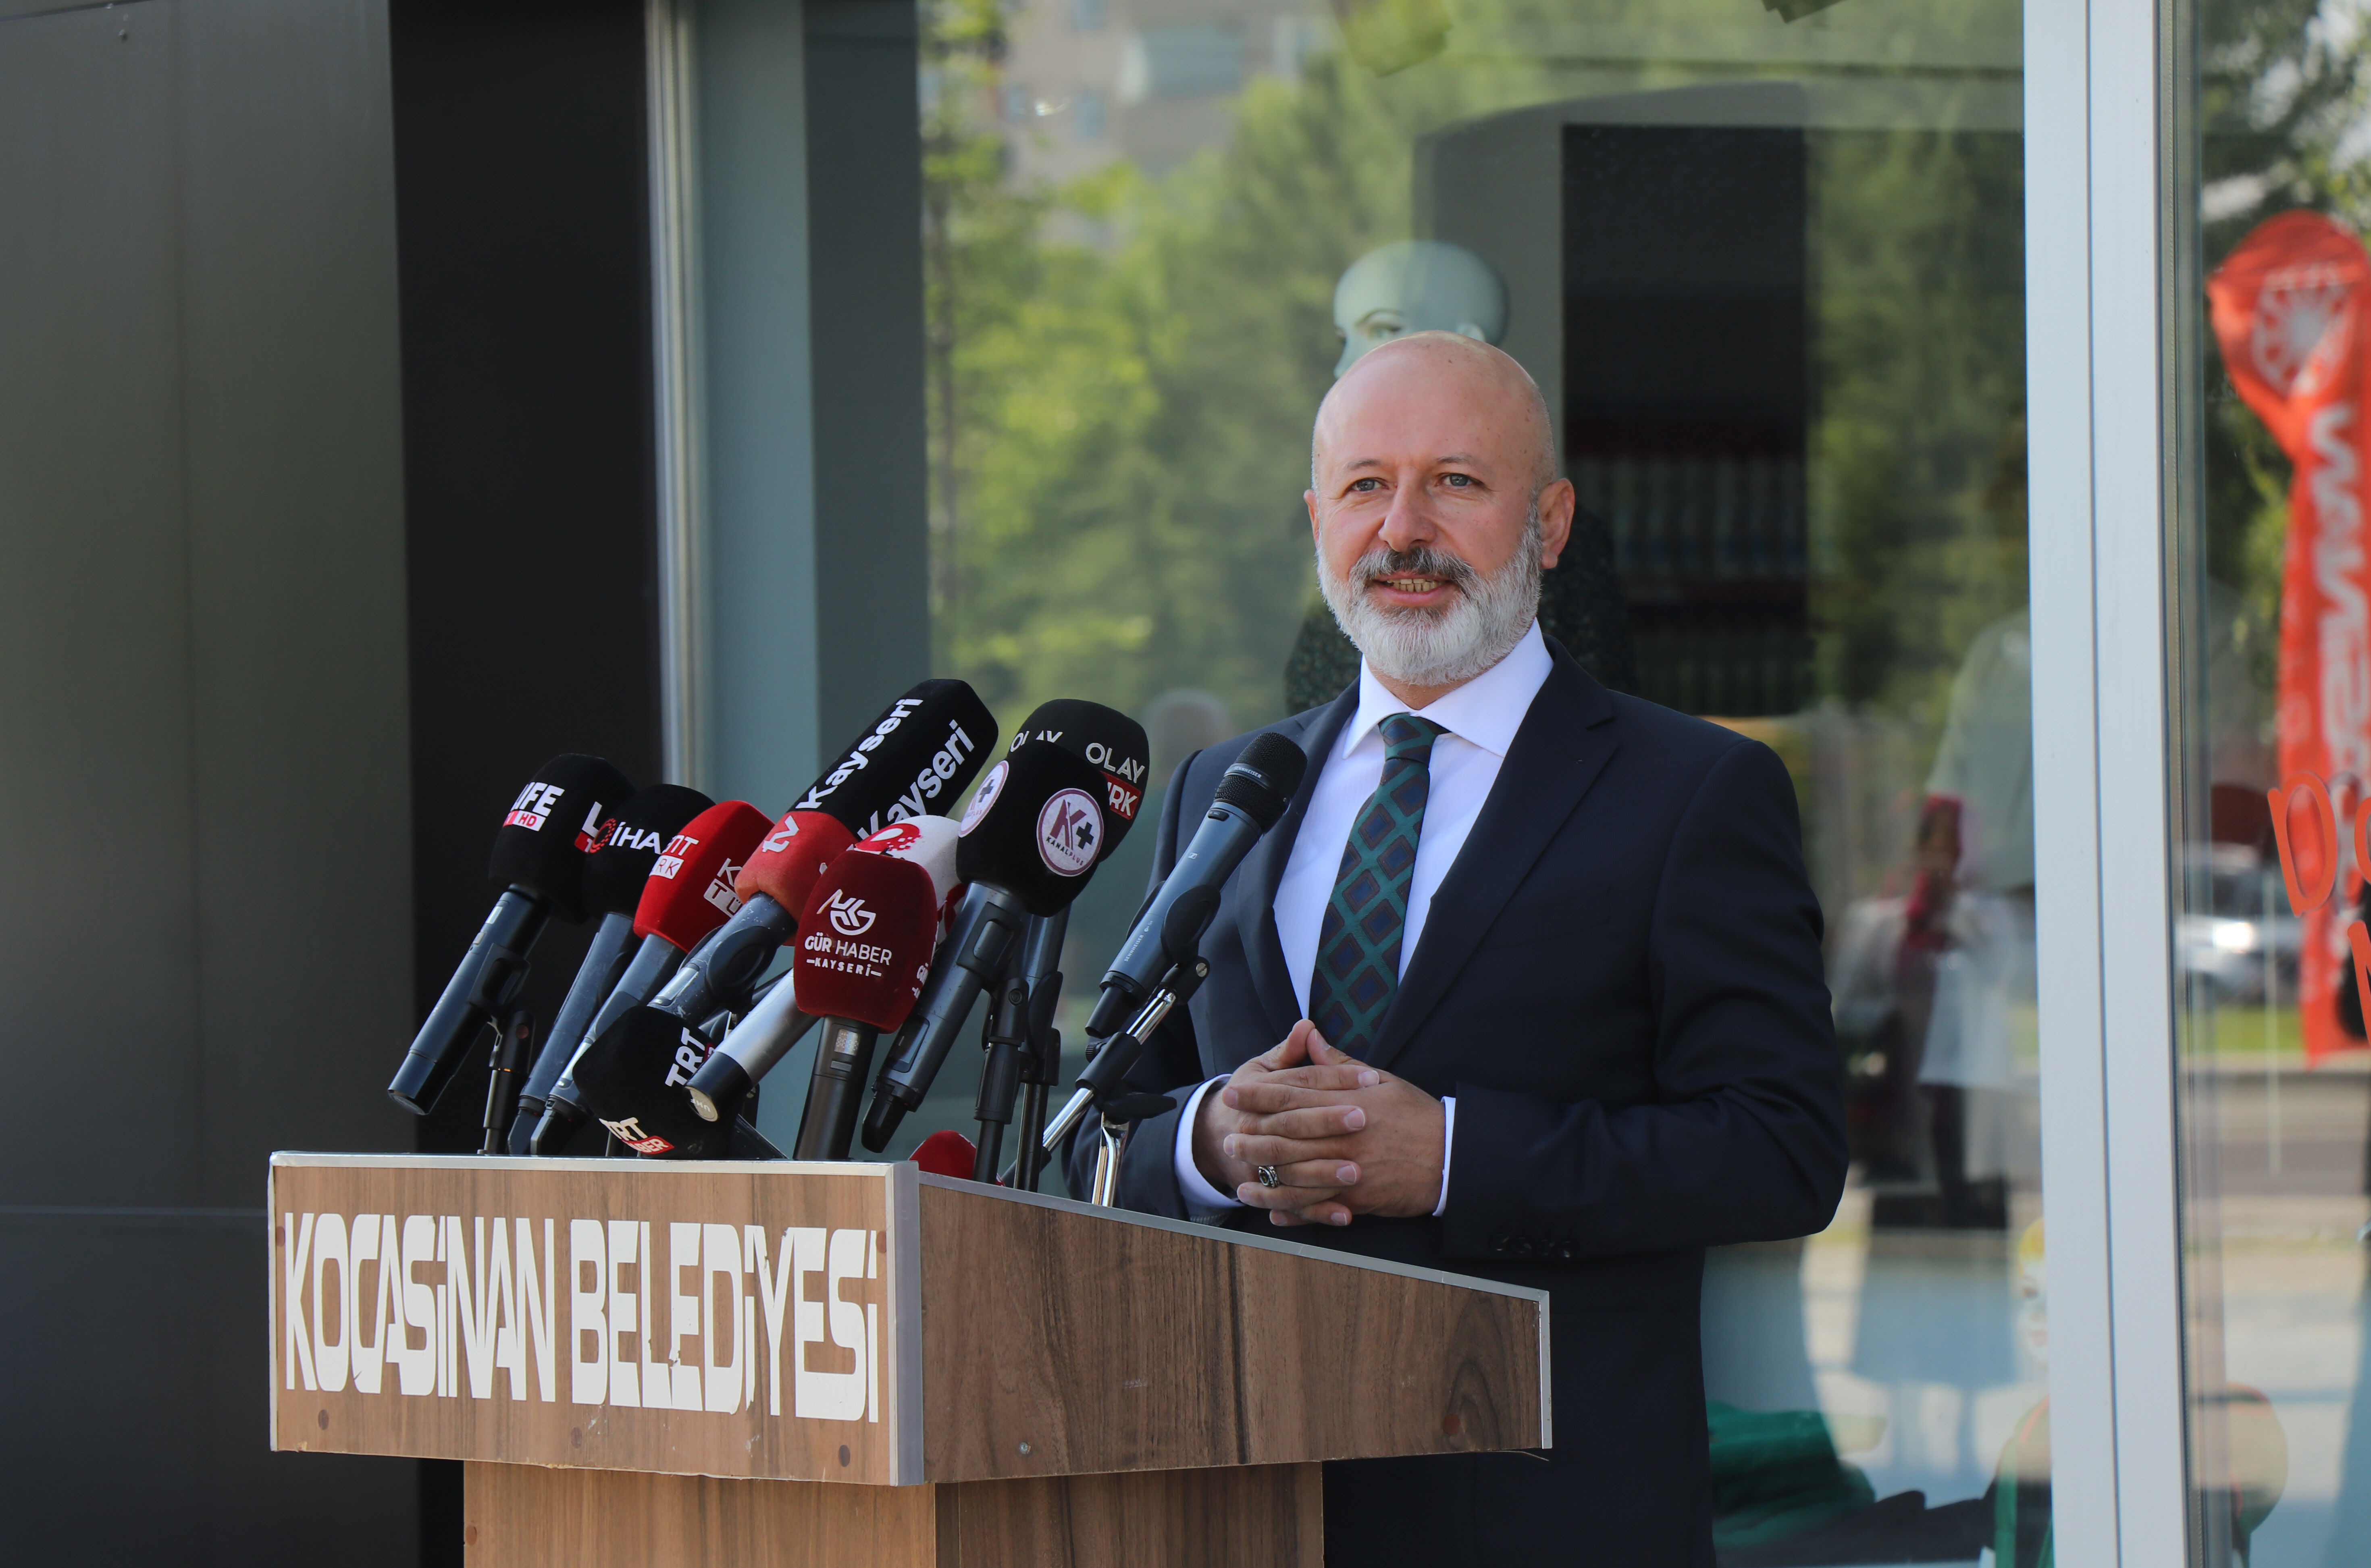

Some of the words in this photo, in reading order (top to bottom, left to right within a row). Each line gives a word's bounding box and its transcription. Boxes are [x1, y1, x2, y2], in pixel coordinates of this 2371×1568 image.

[795, 699, 923, 809] Kayseri
[1086, 742, 1145, 784] OLAY
[1234, 766, 1262, 779] SENNHEISER
[1107, 782, 1138, 817] RK
[518, 813, 537, 827] HD
[762, 815, 799, 853] tv
[655, 858, 680, 876] RK
[1046, 836, 1084, 866] KANALPLUS
[711, 882, 743, 916] TÜ
[805, 932, 832, 953] GÜR
[835, 940, 892, 966] HABER
[1124, 934, 1144, 962] SENNHEISER
[665, 1027, 705, 1087] TRT
[599, 1117, 648, 1141] TRT
